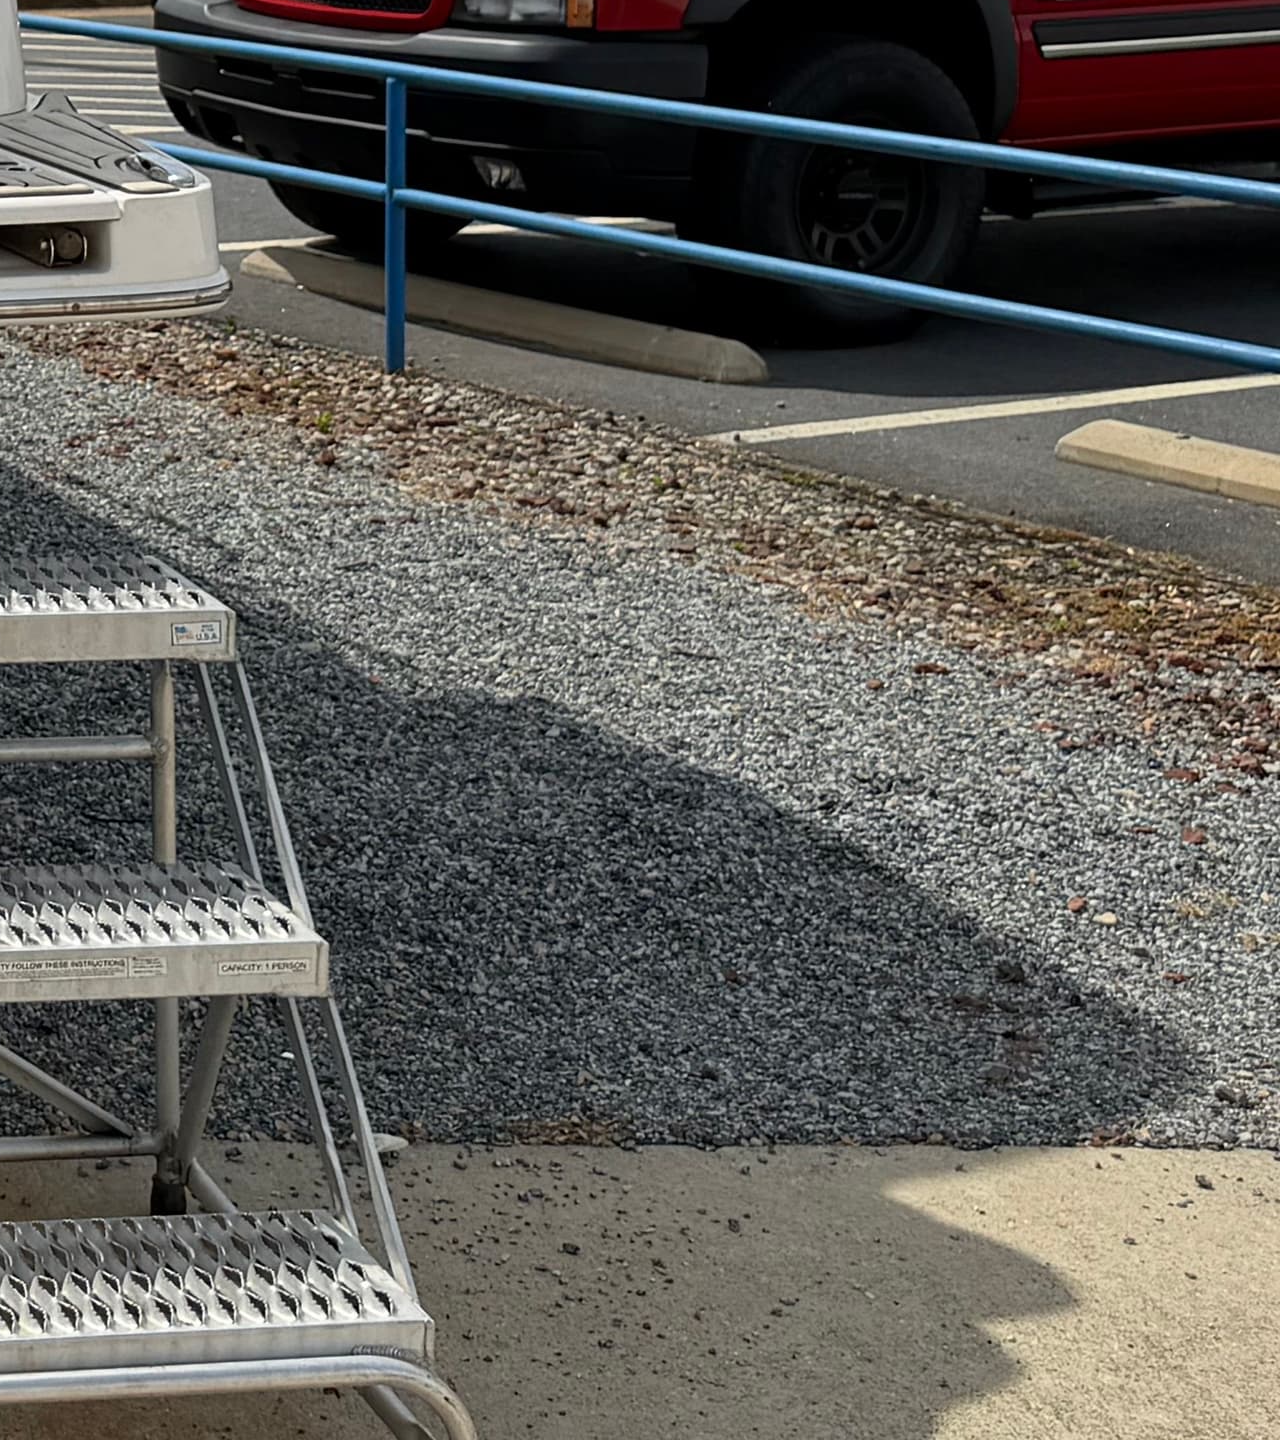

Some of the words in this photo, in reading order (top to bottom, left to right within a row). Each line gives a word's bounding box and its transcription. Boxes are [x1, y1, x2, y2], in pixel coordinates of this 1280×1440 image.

[11, 962, 43, 970] FOLLOW
[45, 961, 68, 969] THESE
[70, 959, 125, 968] INSTRUCTIONS
